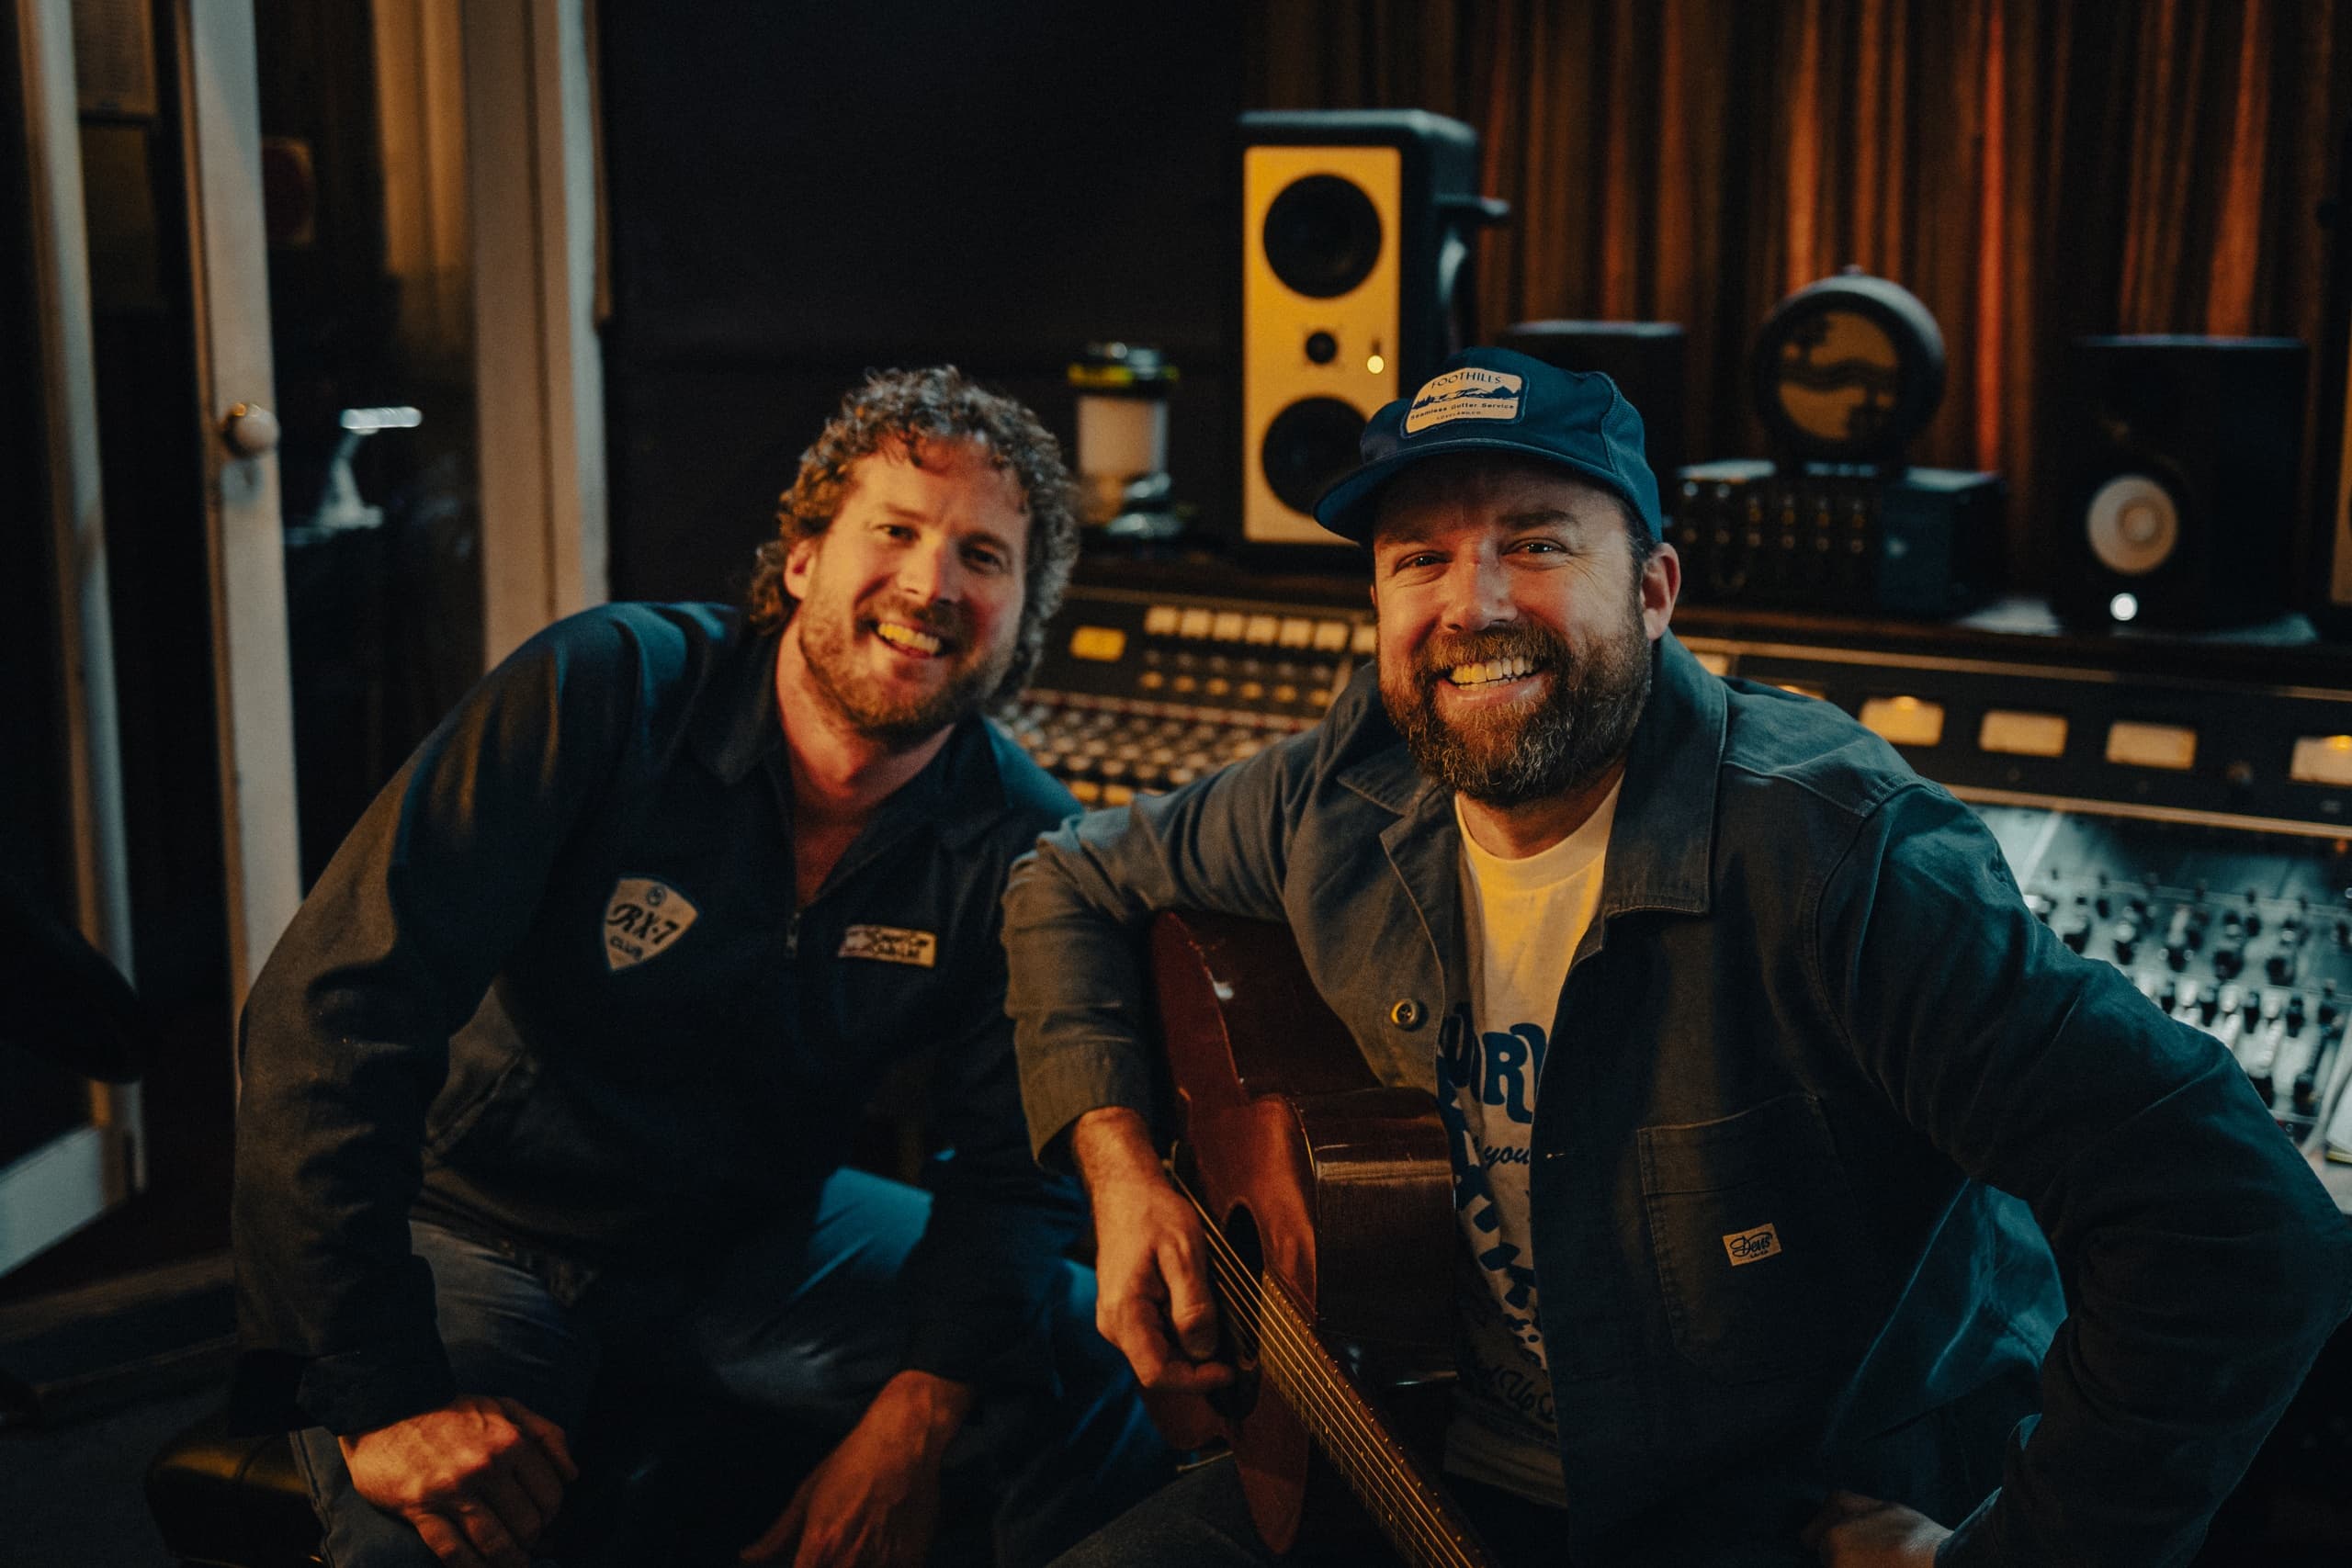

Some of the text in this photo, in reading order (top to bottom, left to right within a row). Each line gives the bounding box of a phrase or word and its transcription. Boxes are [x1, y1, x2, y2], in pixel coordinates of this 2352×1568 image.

[1430, 371, 1502, 389] FOOTHILLS
[1410, 406, 1448, 421] Seamless
[1451, 402, 1477, 411] Gutter
[609, 934, 643, 958] CLUB
